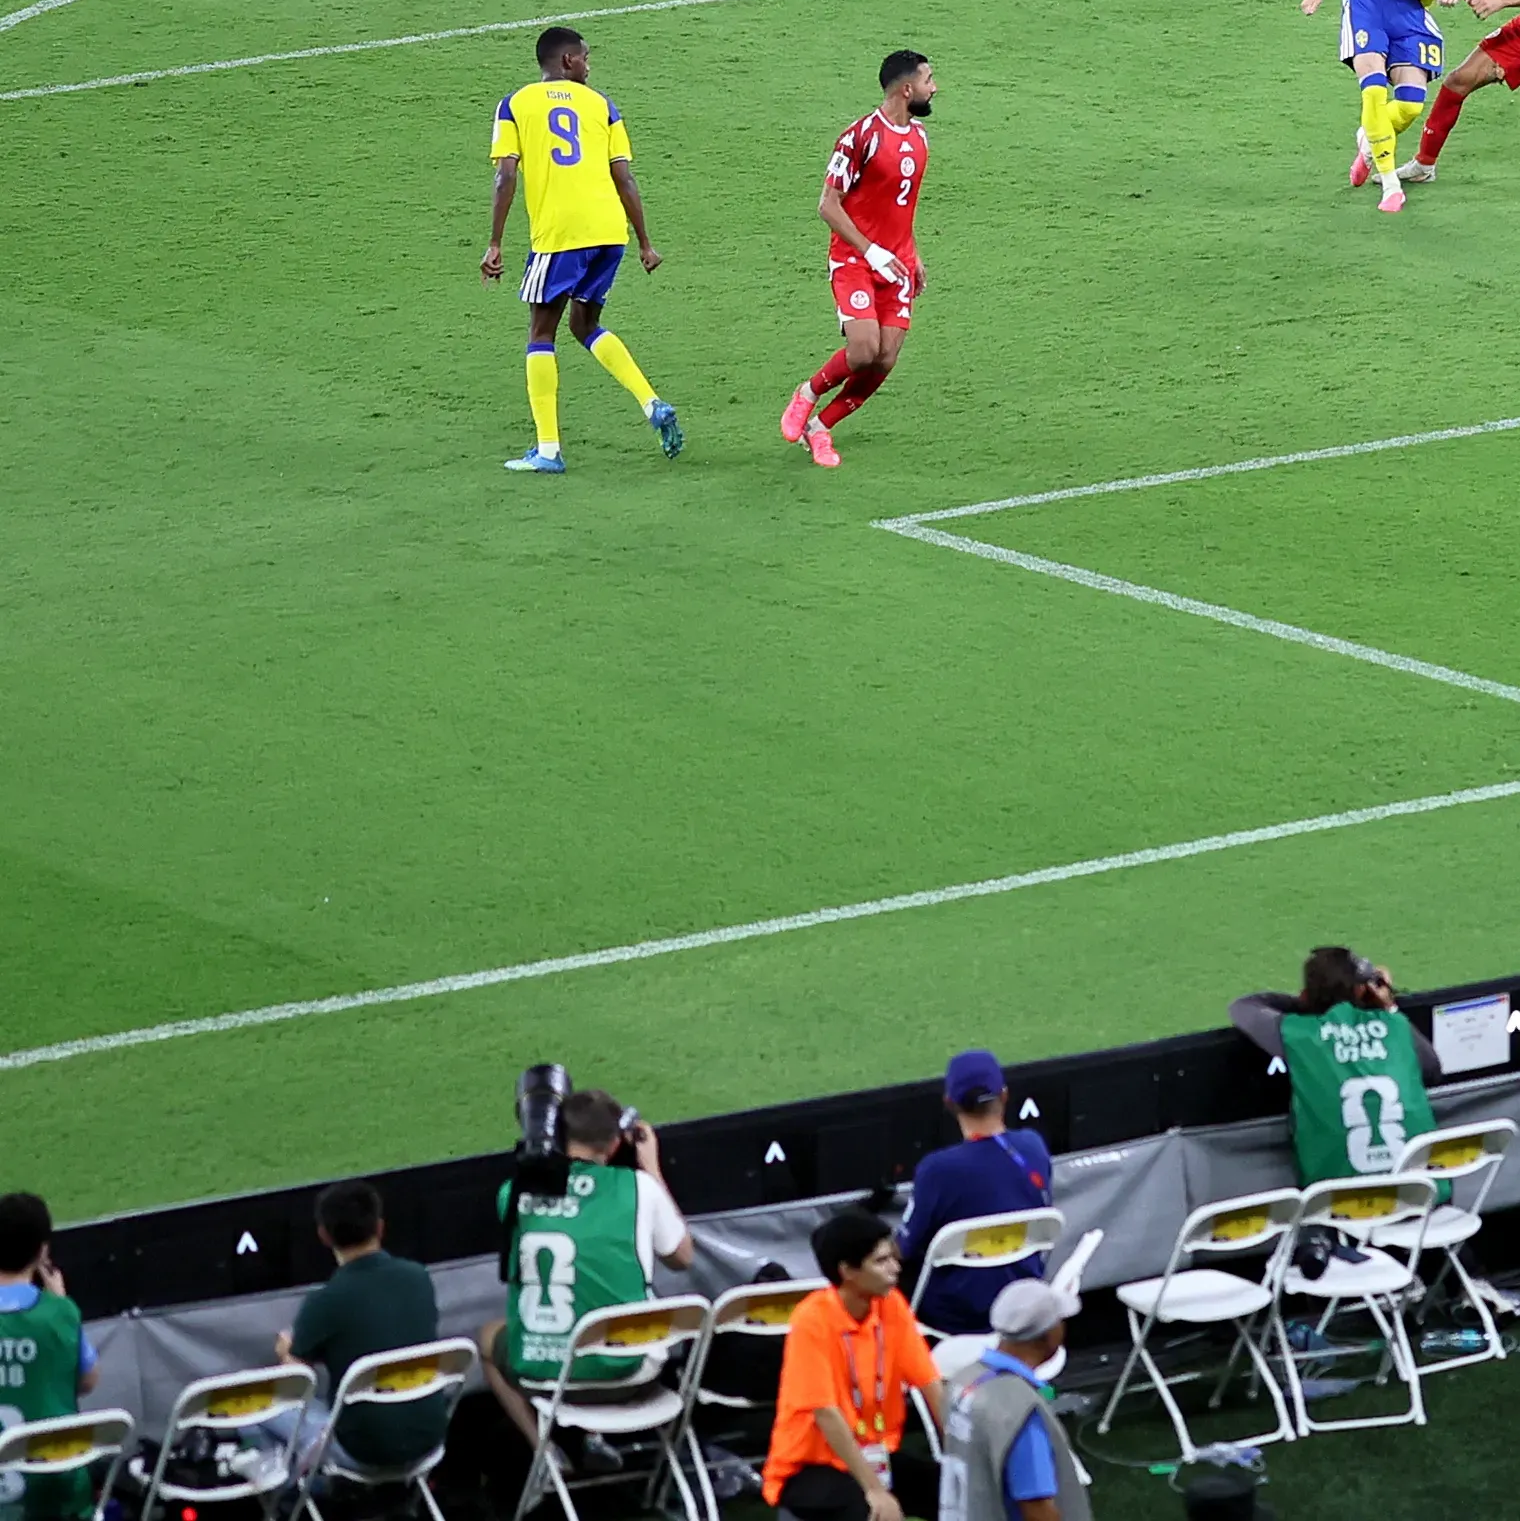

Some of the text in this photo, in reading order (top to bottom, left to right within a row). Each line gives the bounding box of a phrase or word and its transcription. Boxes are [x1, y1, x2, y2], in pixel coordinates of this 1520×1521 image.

[1416, 42, 1441, 68] 19
[547, 91, 572, 101] ISAK
[548, 108, 582, 167] 9
[896, 180, 910, 206] 2
[895, 276, 909, 304] 2
